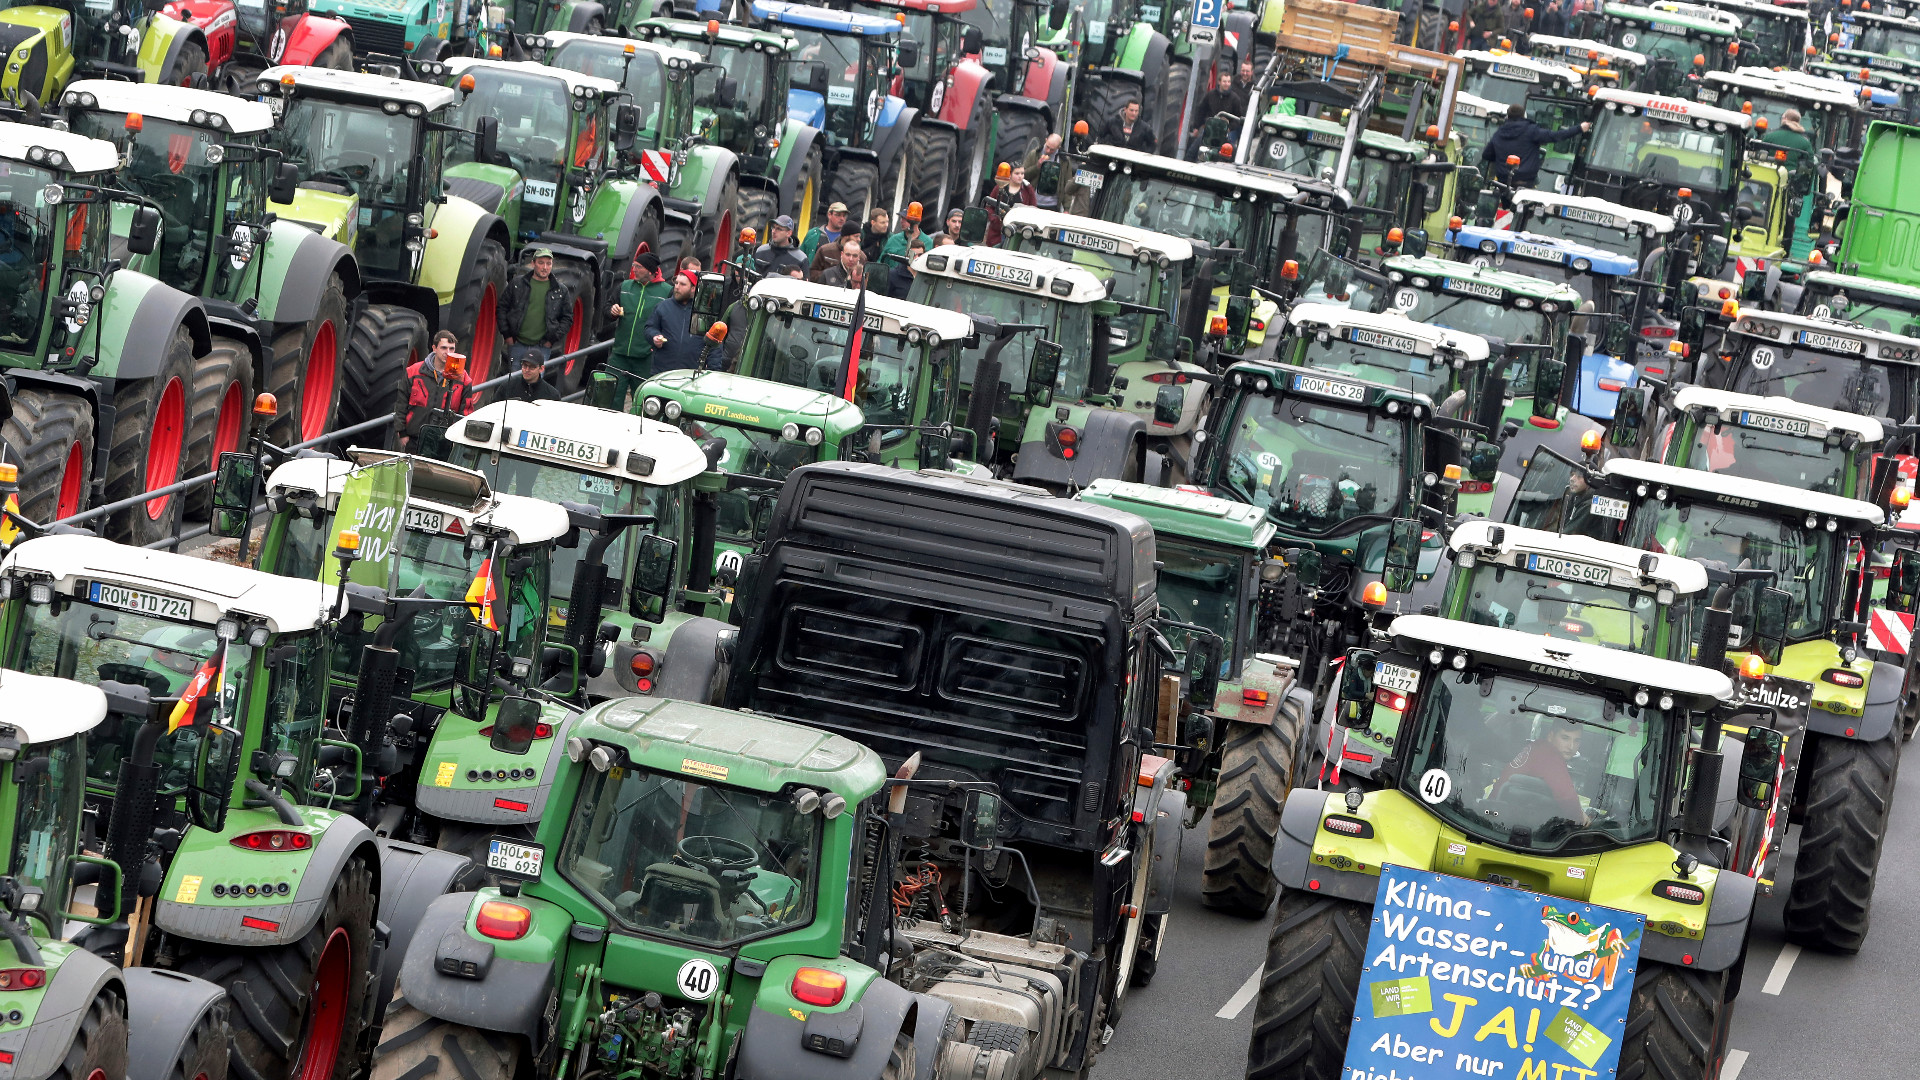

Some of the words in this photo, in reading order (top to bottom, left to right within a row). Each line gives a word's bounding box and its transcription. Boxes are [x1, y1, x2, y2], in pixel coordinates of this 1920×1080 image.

[1198, 0, 1214, 23] P
[1646, 100, 1688, 114] CLAAS
[1272, 143, 1285, 157] 50
[525, 184, 556, 198] SN-OST
[1567, 208, 1582, 217] DBR
[1587, 211, 1597, 220] NR
[1599, 213, 1612, 224] 724
[1067, 233, 1080, 245] NI
[1086, 236, 1100, 248] DH
[1100, 239, 1114, 250] 50
[1515, 243, 1533, 255] ROW
[1537, 248, 1550, 257] WB
[1551, 250, 1562, 260] 37
[974, 261, 996, 275] STD
[1001, 266, 1015, 279] LS
[1017, 270, 1030, 282] 24
[1450, 279, 1468, 290] MST
[1474, 282, 1487, 294] RG
[1488, 286, 1500, 297] 24
[1400, 292, 1414, 307] 50
[820, 307, 840, 320] STD
[863, 316, 880, 329] 721
[1357, 330, 1377, 342] ROW
[1381, 335, 1393, 346] FK
[1395, 338, 1413, 350] 445
[1805, 331, 1826, 345] LRO
[1831, 338, 1840, 348] M
[1840, 341, 1860, 351] 637
[1755, 351, 1772, 366] 50
[1301, 378, 1324, 391] ROW
[1331, 383, 1346, 396] CS
[1348, 387, 1363, 399] 28
[727, 410, 760, 423] Landtechnik
[1748, 414, 1770, 427] LRO
[1777, 420, 1784, 429] S
[1786, 421, 1808, 433] 610
[530, 436, 547, 449] NI
[556, 440, 575, 455] BA
[577, 445, 594, 460] 63
[1262, 454, 1276, 467] 50
[593, 484, 610, 494] 623
[1598, 498, 1610, 507] DM
[1716, 494, 1760, 508] CLAAS
[1594, 505, 1606, 514] LH
[1608, 509, 1624, 518] 110
[1536, 558, 1563, 572] LRO
[1572, 564, 1581, 576] S
[1583, 566, 1609, 581] 607
[101, 586, 131, 603] ROW
[140, 593, 159, 611] TD
[161, 599, 188, 617] 724
[1384, 665, 1400, 677] DM
[1529, 663, 1580, 680] CLAAS
[1380, 675, 1395, 687] LH
[1398, 678, 1412, 689] 77
[1424, 774, 1446, 797] 40
[500, 845, 523, 859] HOL
[491, 856, 507, 868] BG
[514, 860, 538, 873] 693
[1382, 909, 1525, 959] Wasser-
[1542, 952, 1597, 979] und
[684, 966, 712, 993] 40
[1373, 944, 1601, 1010] Artenschutz?
[1380, 986, 1400, 995] LAND
[1385, 994, 1401, 1002] WIR
[1429, 992, 1541, 1053] JA!
[1564, 1017, 1583, 1032] LAND
[1564, 1026, 1578, 1039] WIR
[1370, 1032, 1444, 1064] Aber
[1455, 1053, 1504, 1076] nur
